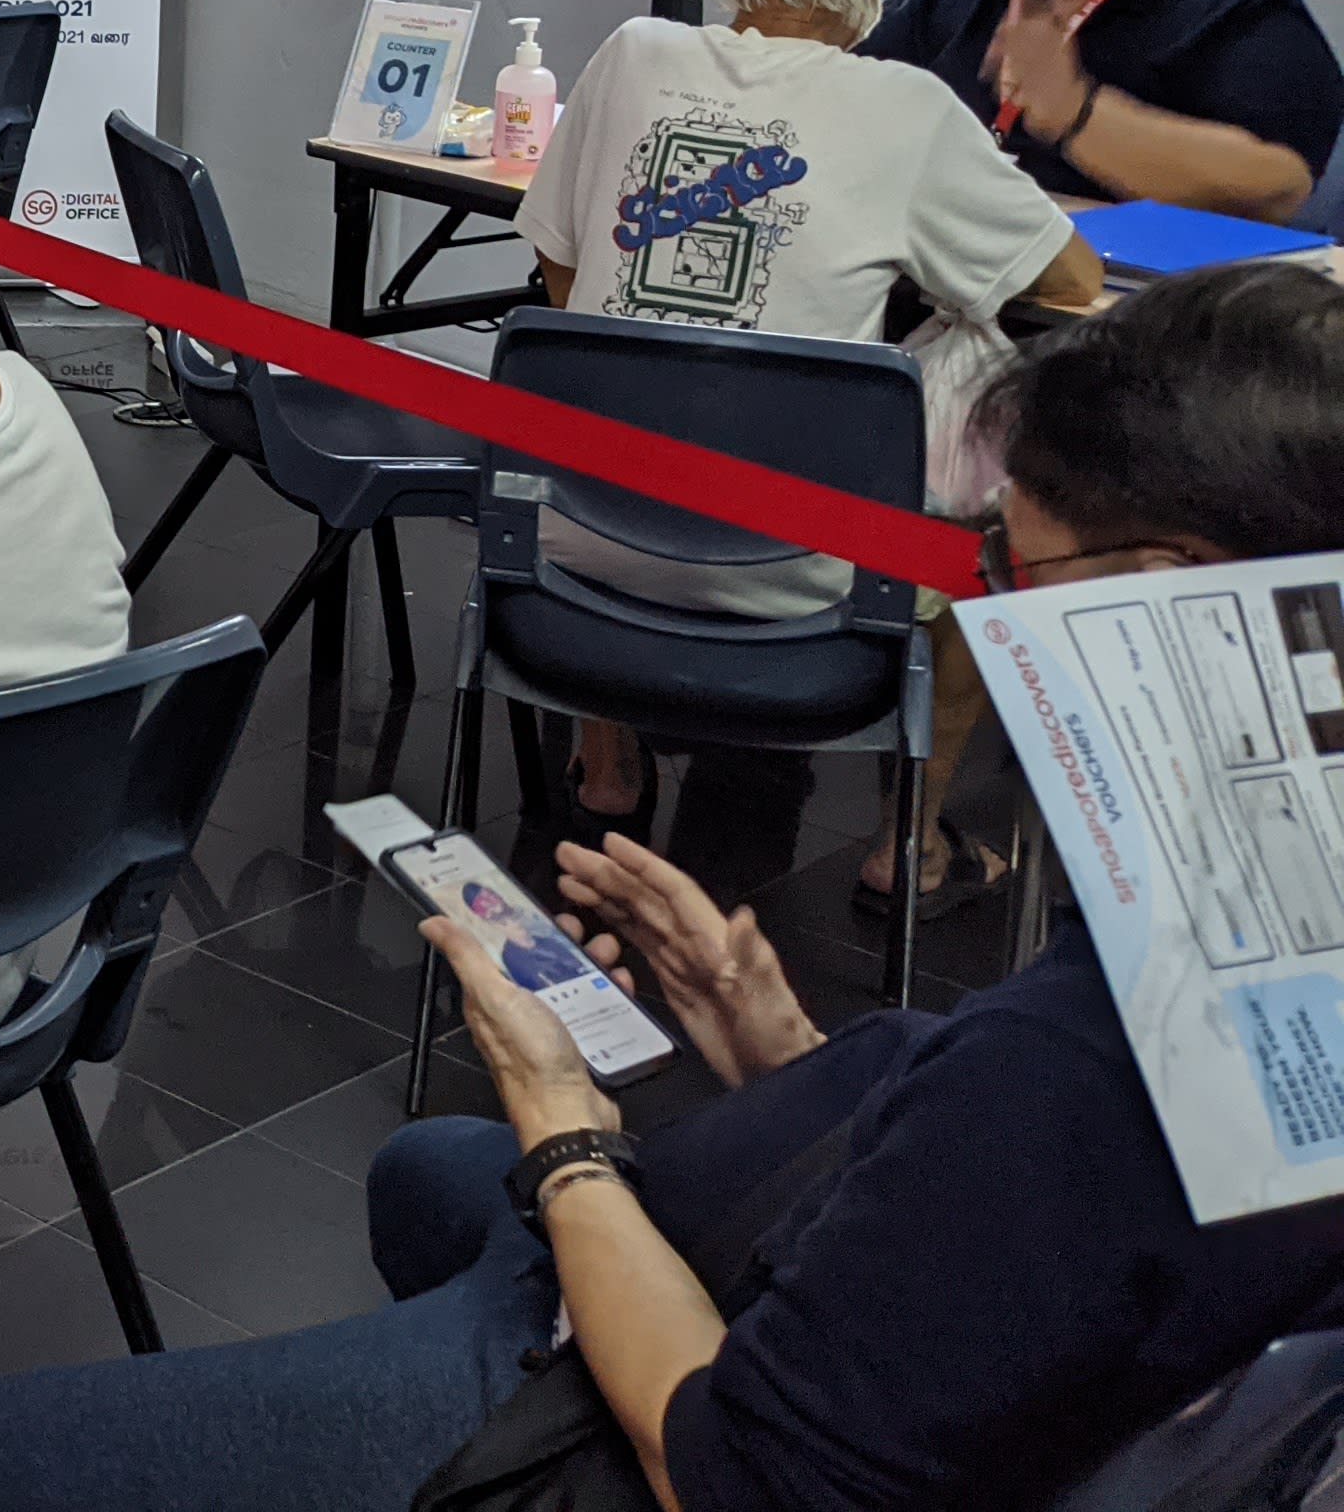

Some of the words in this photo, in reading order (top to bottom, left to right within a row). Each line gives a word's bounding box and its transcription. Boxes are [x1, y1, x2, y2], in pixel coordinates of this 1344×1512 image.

[56, 0, 92, 17] 021
[57, 31, 84, 44] 021
[387, 41, 437, 56] COUNTER
[378, 59, 431, 97] 01
[28, 200, 52, 217] SG
[66, 207, 120, 220] OFFICE
[1278, 1058, 1322, 1144] REDEEM
[1269, 1079, 1306, 1148] READY
